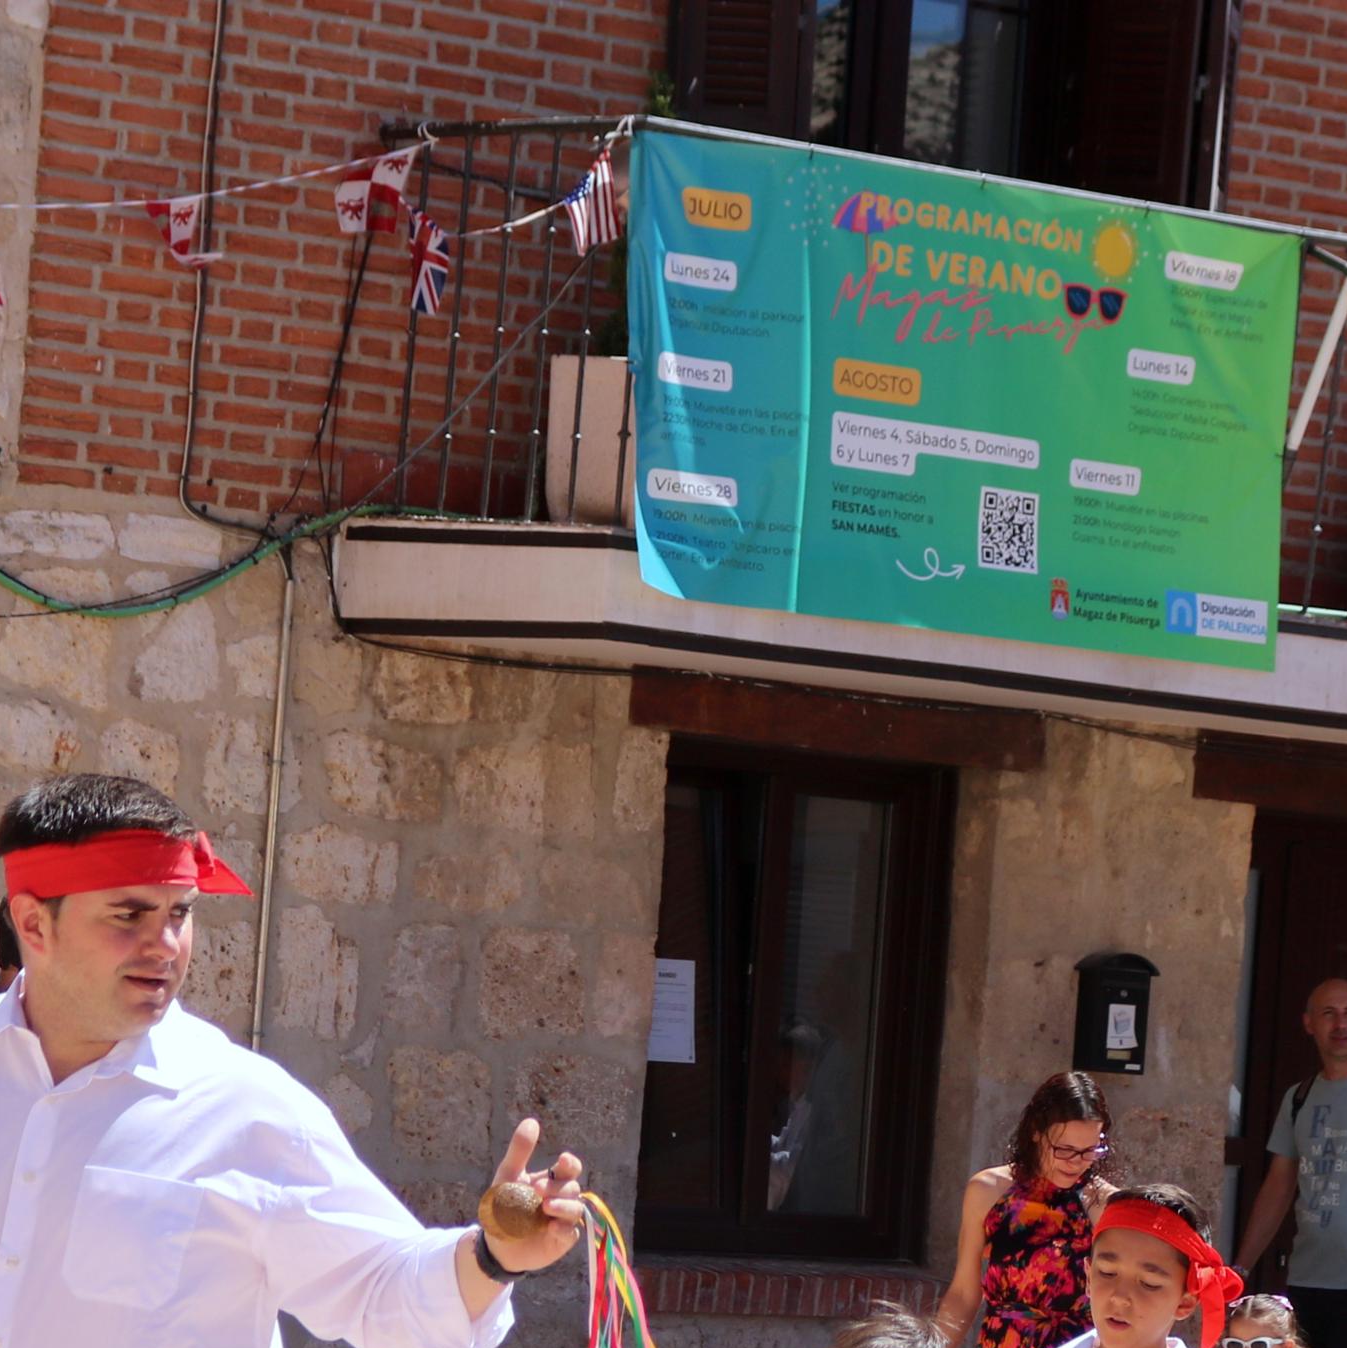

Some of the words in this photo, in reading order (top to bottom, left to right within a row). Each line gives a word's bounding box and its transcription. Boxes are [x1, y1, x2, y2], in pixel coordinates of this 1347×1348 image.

[688, 197, 743, 221] JULIO
[859, 191, 1083, 255] PROGRAMACIÓN
[670, 259, 710, 280] Lunes
[713, 267, 731, 282] 24
[872, 240, 915, 277] DE
[926, 249, 1063, 300] VERANO
[1170, 258, 1221, 281] Viernes
[1224, 269, 1237, 283] 18
[830, 264, 996, 344] Magaz
[922, 310, 961, 344] de
[967, 309, 1103, 355] Pisuerga
[664, 357, 710, 382] Viernes
[713, 368, 727, 383] 21
[1132, 356, 1171, 375] Lunes
[1174, 363, 1189, 377] 14
[839, 368, 914, 396] AGOSTO
[837, 419, 887, 442] Viernes
[890, 428, 903, 444] 4,
[906, 429, 957, 450] Sábado
[959, 437, 971, 454] 5,
[975, 439, 1036, 464] Domingo
[836, 443, 845, 459] 6
[847, 448, 855, 461] y
[857, 447, 899, 466] Lunes
[902, 453, 911, 468] 7
[654, 476, 712, 497] Viernes
[715, 484, 732, 499] 28
[1075, 466, 1123, 487] Viernes
[1125, 473, 1136, 488] 11
[832, 481, 850, 493] Ver
[852, 482, 927, 504] programación
[832, 499, 877, 516] FIESTAS
[878, 508, 891, 517] en
[893, 508, 924, 522] honor
[927, 516, 934, 525] a
[832, 518, 855, 533] SAN
[857, 520, 901, 539] MAMÉS.
[1076, 588, 1145, 608] Ayuntamiento
[1147, 597, 1159, 609] de
[1201, 601, 1256, 619] Diputación
[1073, 605, 1104, 621] Magaz
[1105, 611, 1118, 623] de
[1119, 612, 1161, 630] Pisuerga
[1202, 617, 1216, 629] DE
[1217, 619, 1266, 636] PALENCIA
